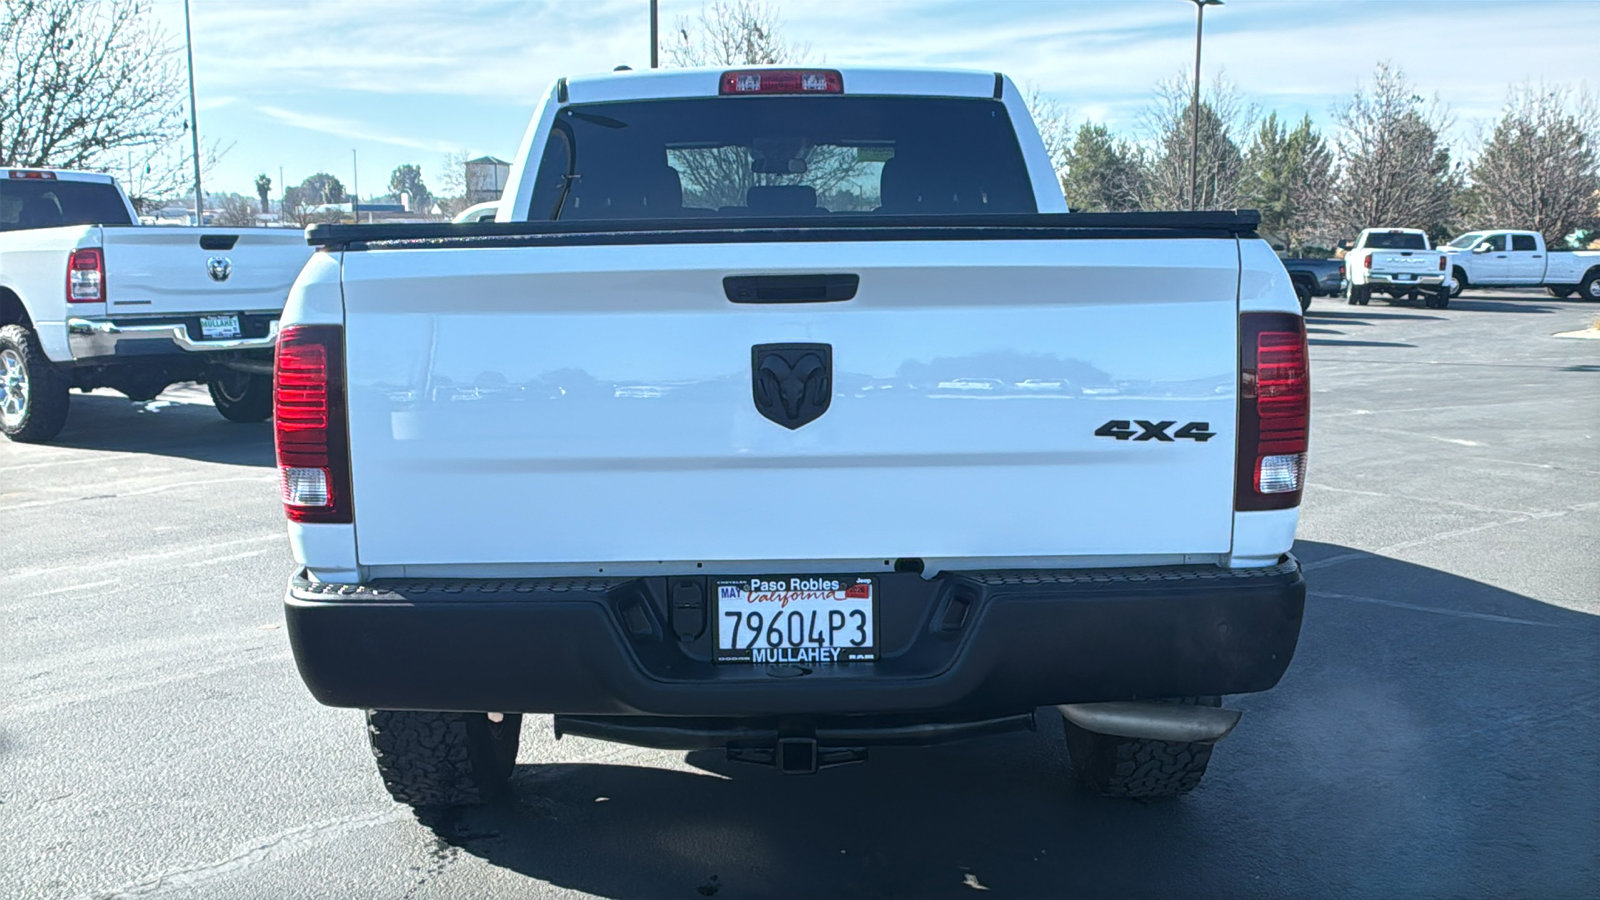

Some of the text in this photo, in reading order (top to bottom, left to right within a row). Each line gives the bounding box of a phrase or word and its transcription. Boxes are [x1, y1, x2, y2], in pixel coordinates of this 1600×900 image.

[751, 578, 840, 591] Paso Robles
[721, 587, 742, 599] MAY
[747, 590, 847, 608] California
[724, 609, 867, 649] 79604P3
[753, 647, 841, 662] MULLAHEY
